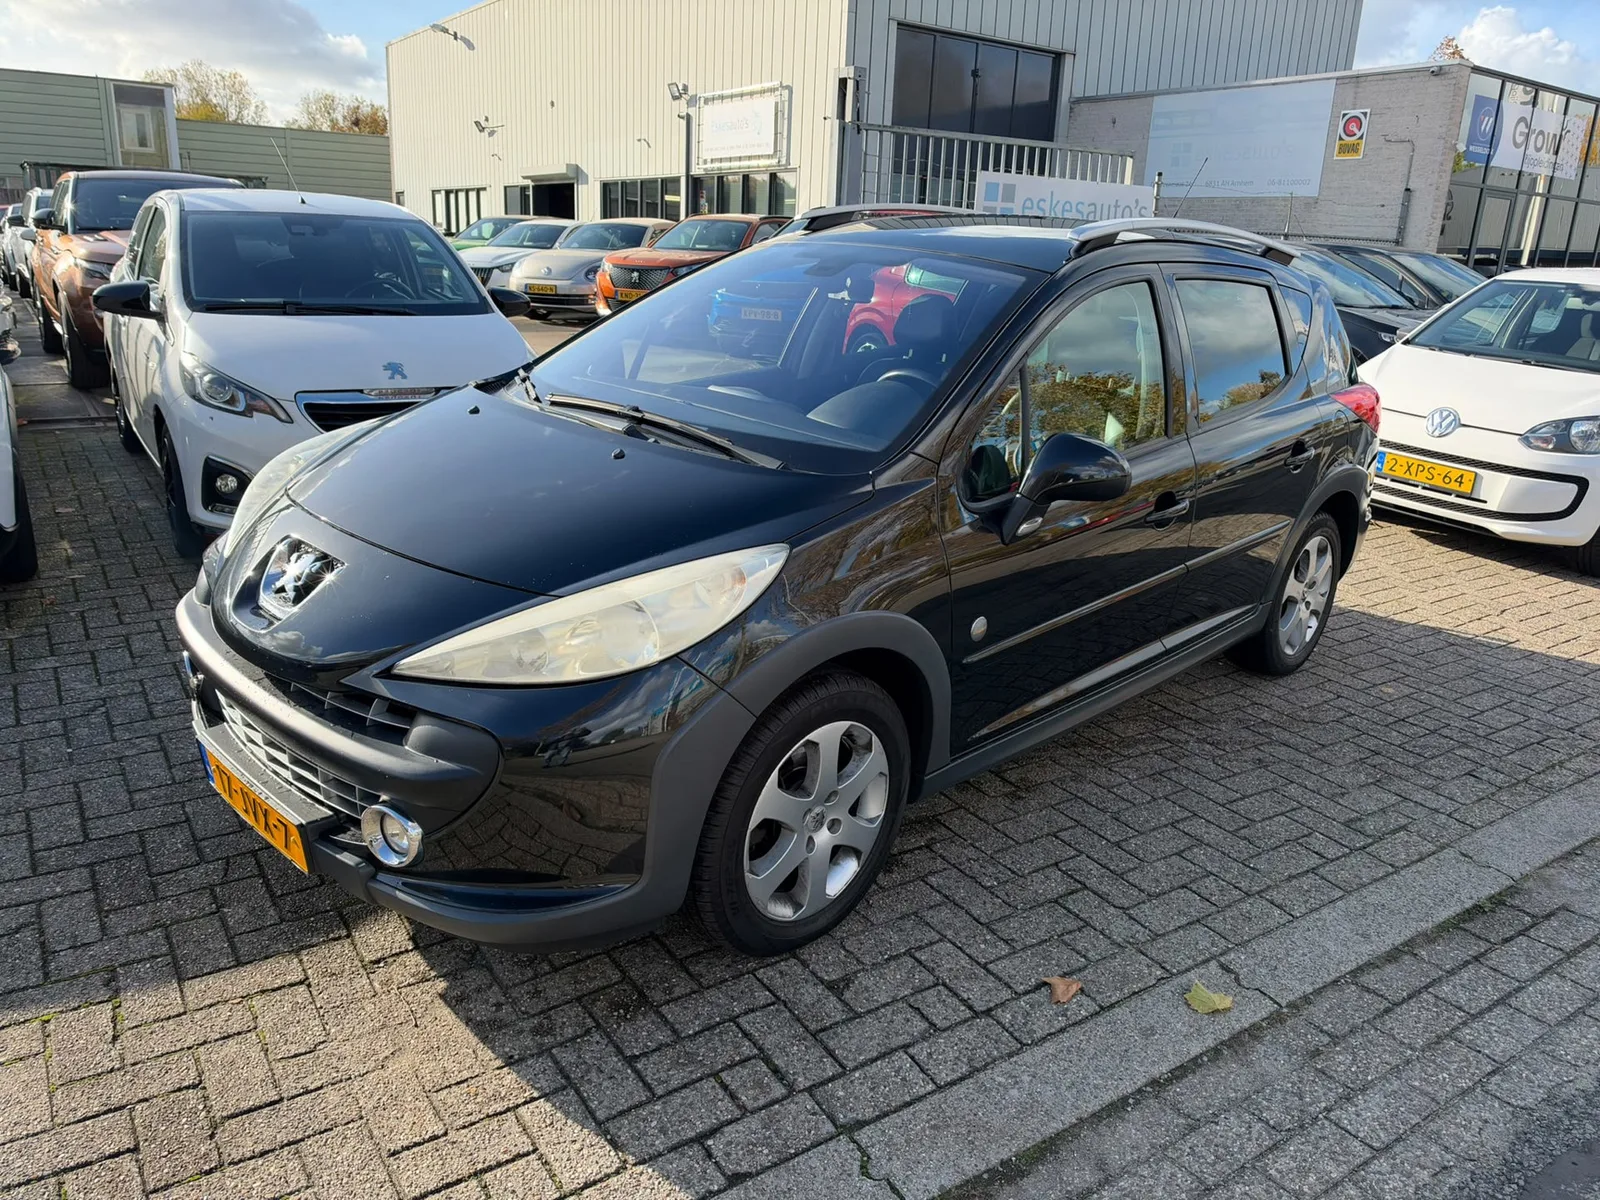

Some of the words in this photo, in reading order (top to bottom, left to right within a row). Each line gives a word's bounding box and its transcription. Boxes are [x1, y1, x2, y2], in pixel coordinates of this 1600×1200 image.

[1338, 142, 1361, 155] BOVAG
[1231, 179, 1254, 188] Arnhem
[1021, 190, 1148, 222] eskesauto's
[1388, 457, 1465, 488] 2-XPS-64
